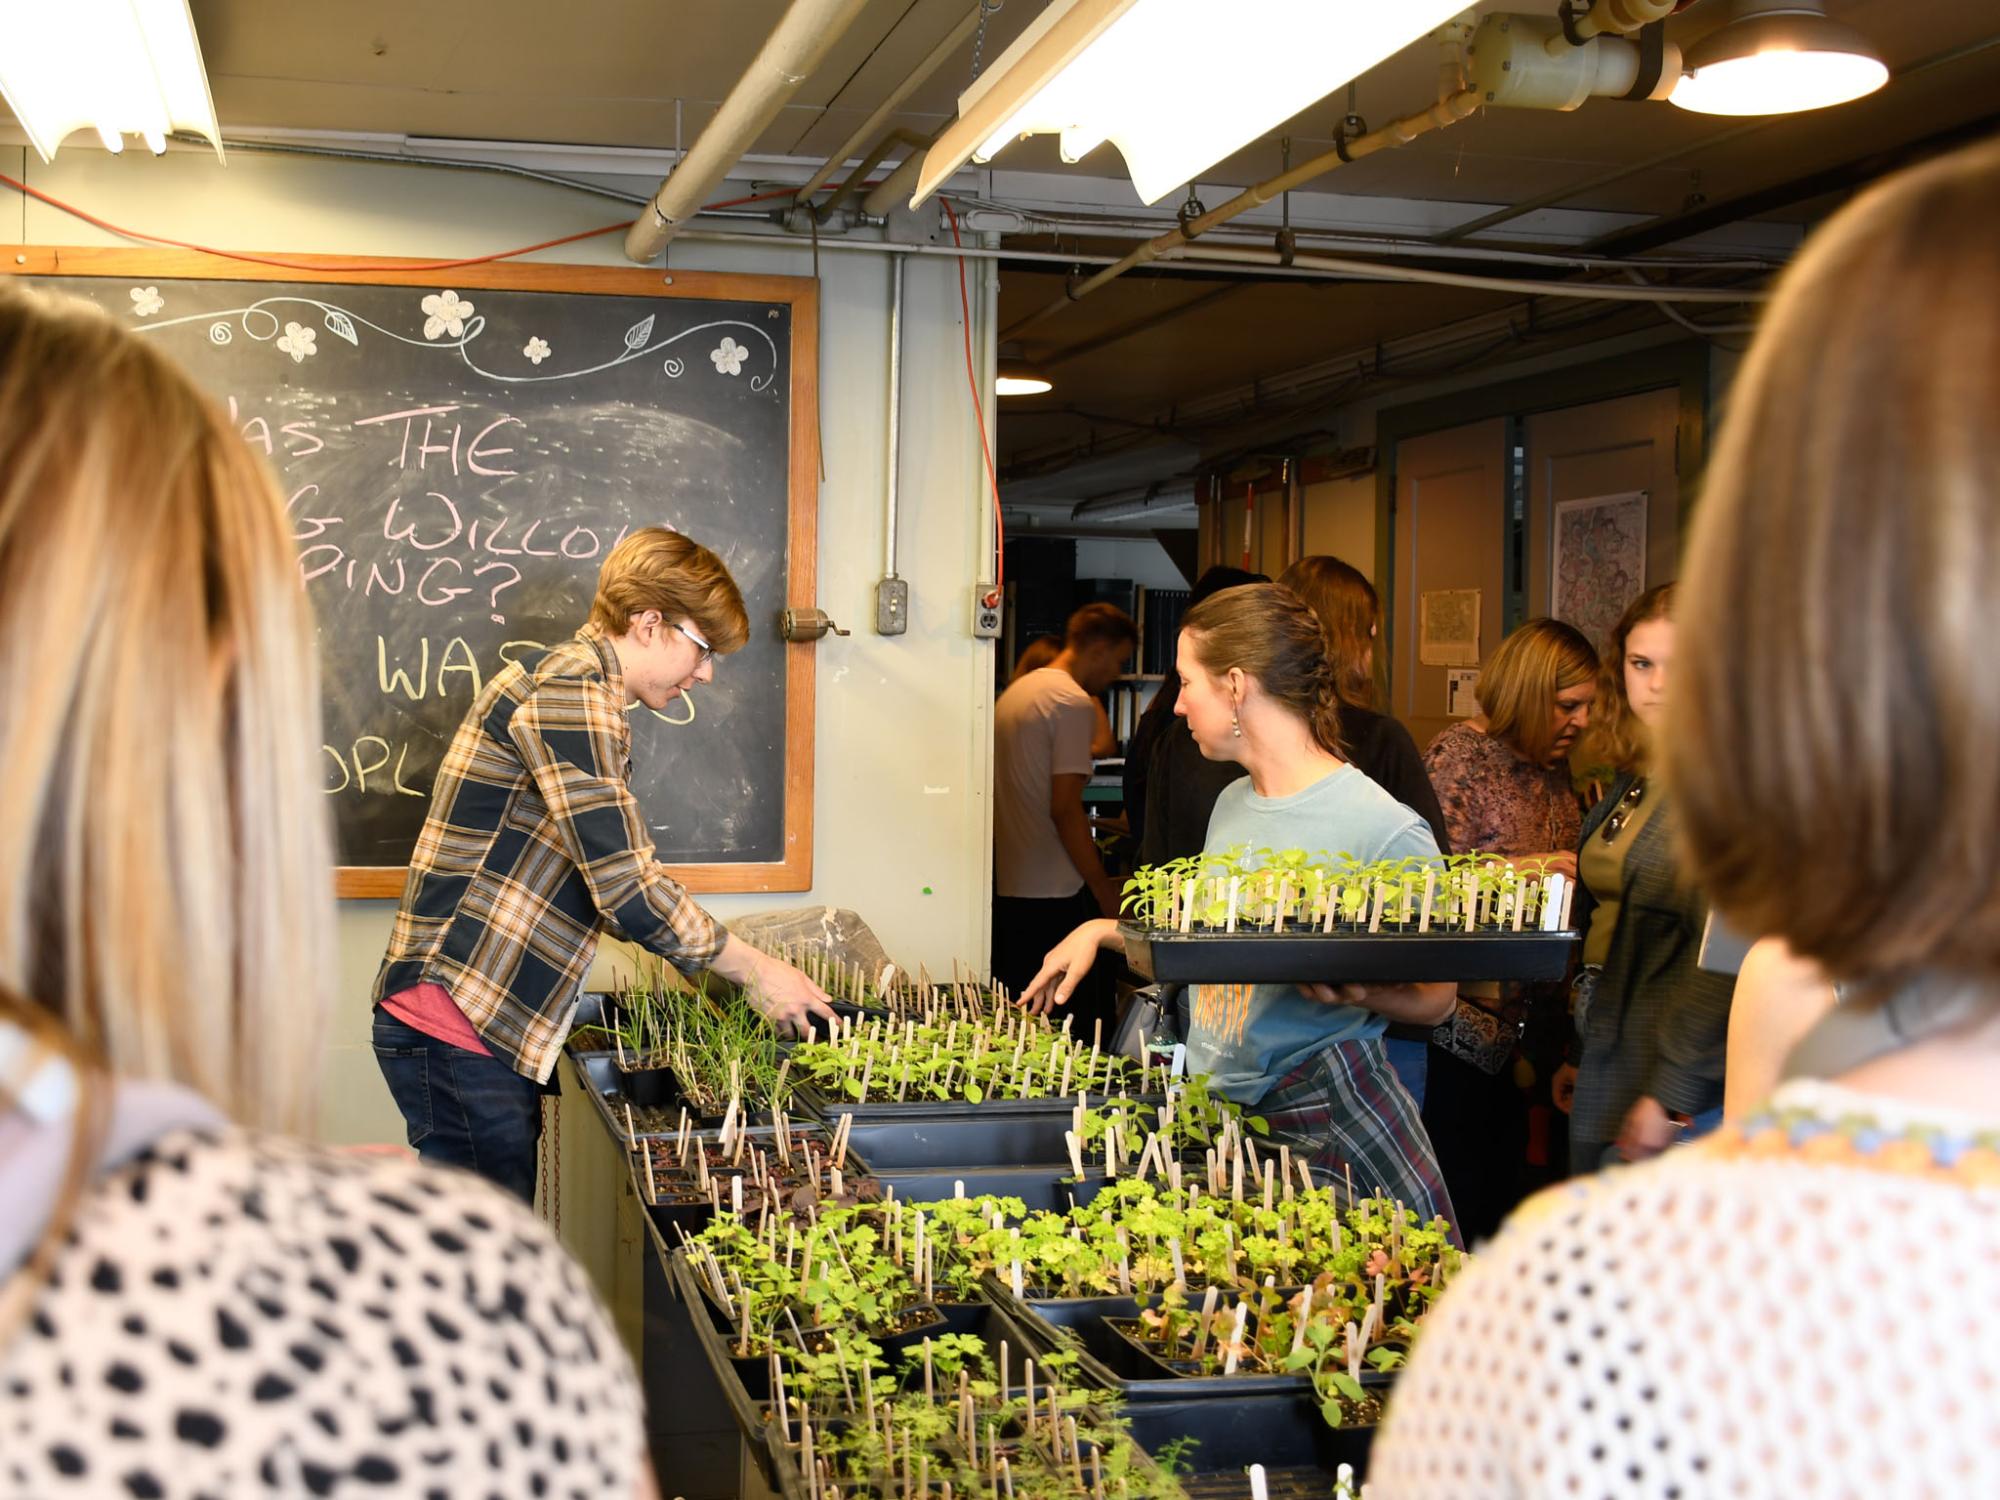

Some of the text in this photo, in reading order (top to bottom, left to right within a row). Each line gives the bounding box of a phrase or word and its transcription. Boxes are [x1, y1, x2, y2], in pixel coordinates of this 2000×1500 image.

[228, 396, 524, 477] AS THE
[283, 484, 677, 559] G WILLO
[297, 544, 522, 626] PING?
